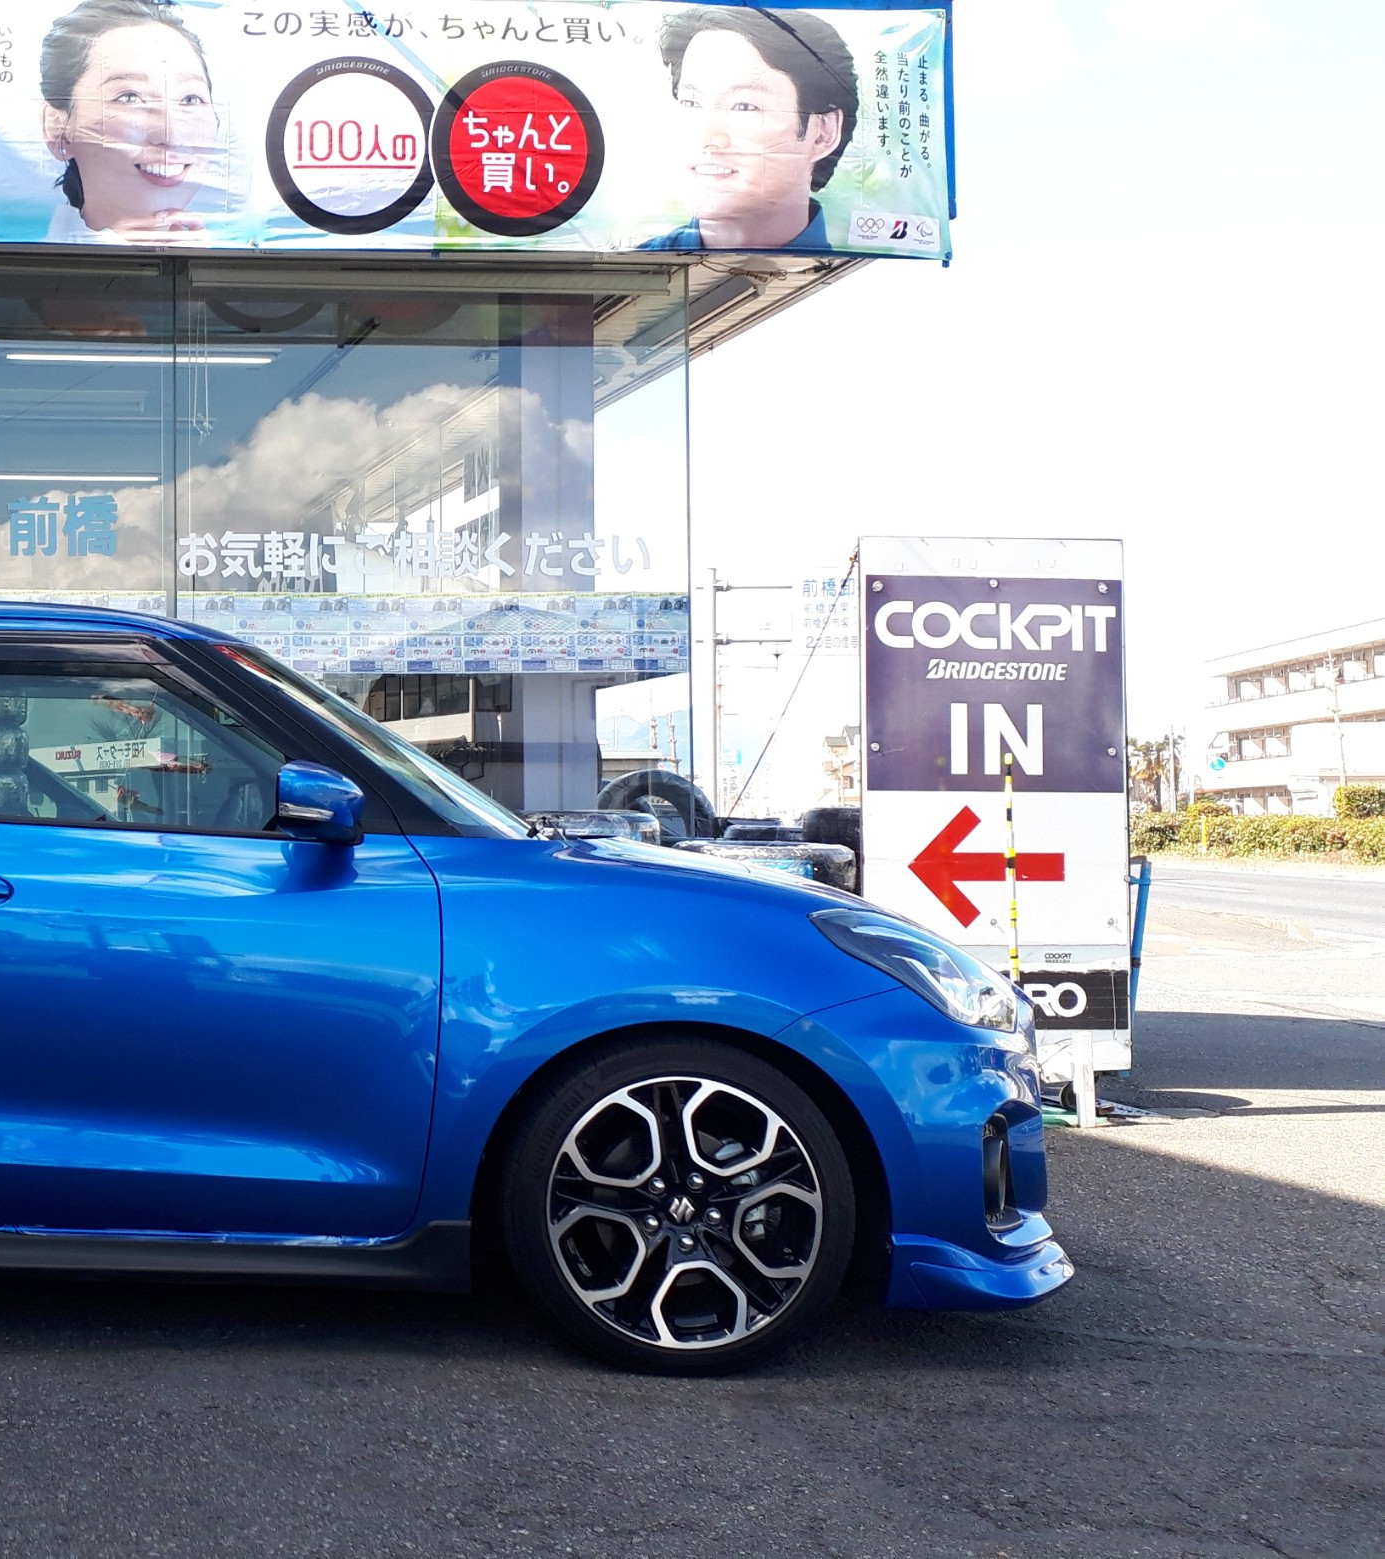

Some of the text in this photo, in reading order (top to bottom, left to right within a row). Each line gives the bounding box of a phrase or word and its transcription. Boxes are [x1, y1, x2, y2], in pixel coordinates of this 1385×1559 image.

[315, 60, 390, 76] BRIDGESTONE
[481, 64, 553, 80] BRIDGESTONE
[874, 49, 891, 156] 全然違います。
[897, 51, 912, 179] 当たり前のことが
[917, 55, 932, 169] 止まる。曲がる。
[293, 119, 417, 162] 100人の
[462, 110, 572, 150] ちゃんと
[481, 152, 570, 194] 買い。
[7, 494, 118, 557] 前橋
[177, 530, 651, 578] お気軽にご相談ください
[874, 600, 1117, 652] COCKPIT
[926, 658, 1068, 681] BRIDGESTONE
[950, 702, 1044, 776] IN
[1044, 952, 1072, 960] COCKPIT
